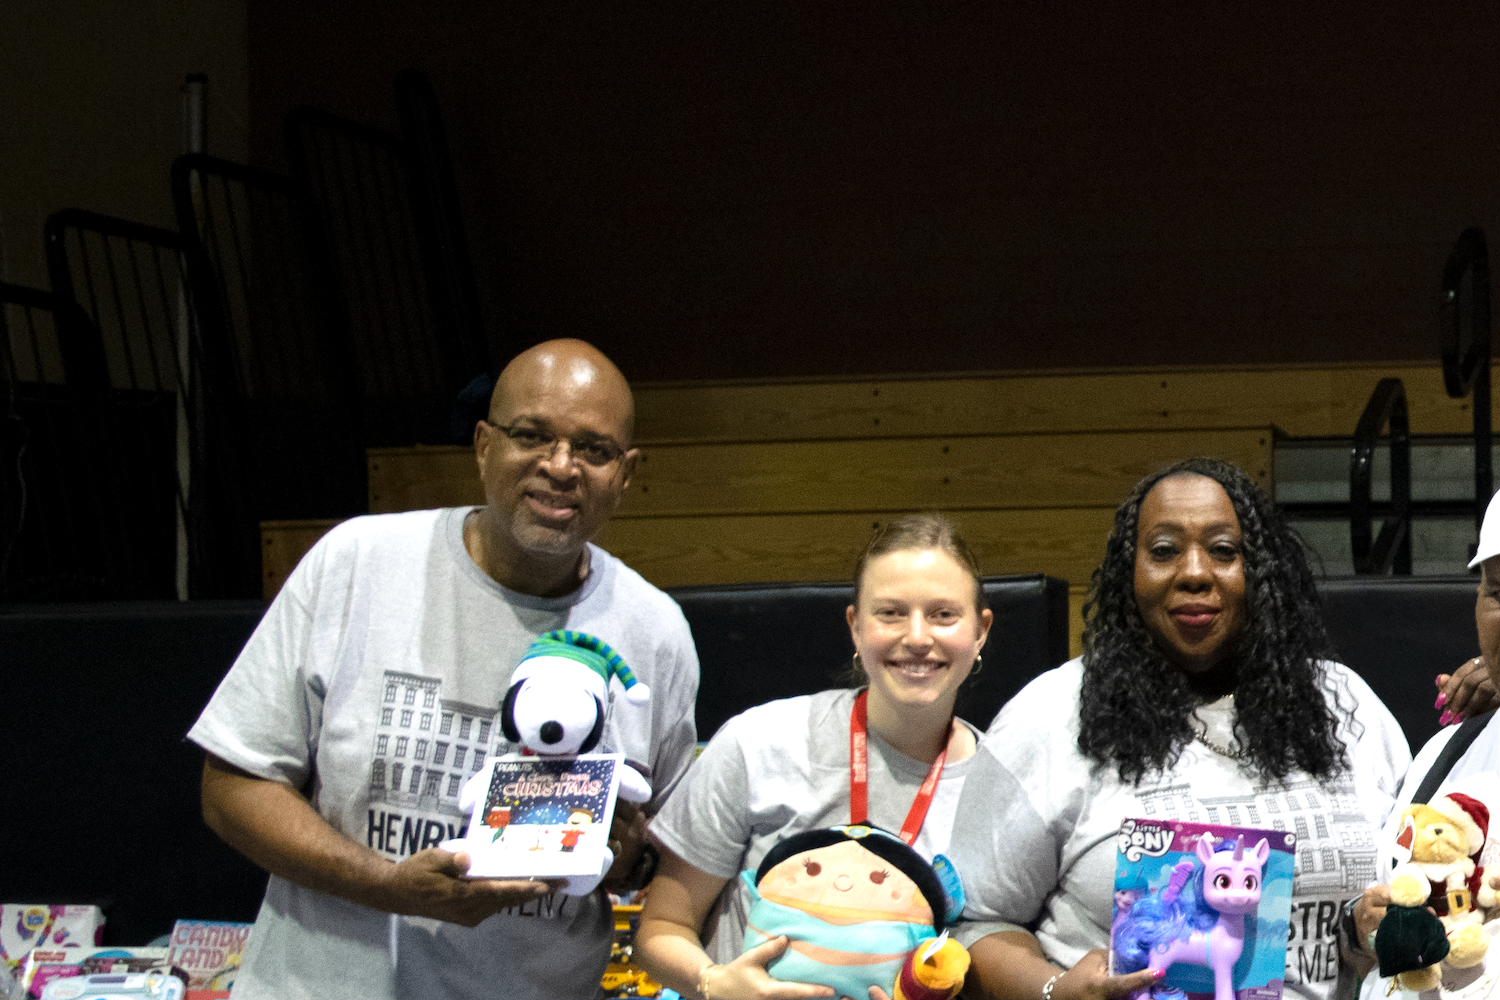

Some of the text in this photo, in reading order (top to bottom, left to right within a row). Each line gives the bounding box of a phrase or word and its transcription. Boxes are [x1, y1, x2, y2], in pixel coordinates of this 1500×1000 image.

[497, 762, 533, 772] PEANUTS
[503, 781, 602, 797] CHRISTMAS
[1118, 830, 1175, 859] PONY
[167, 948, 224, 968] LAND
